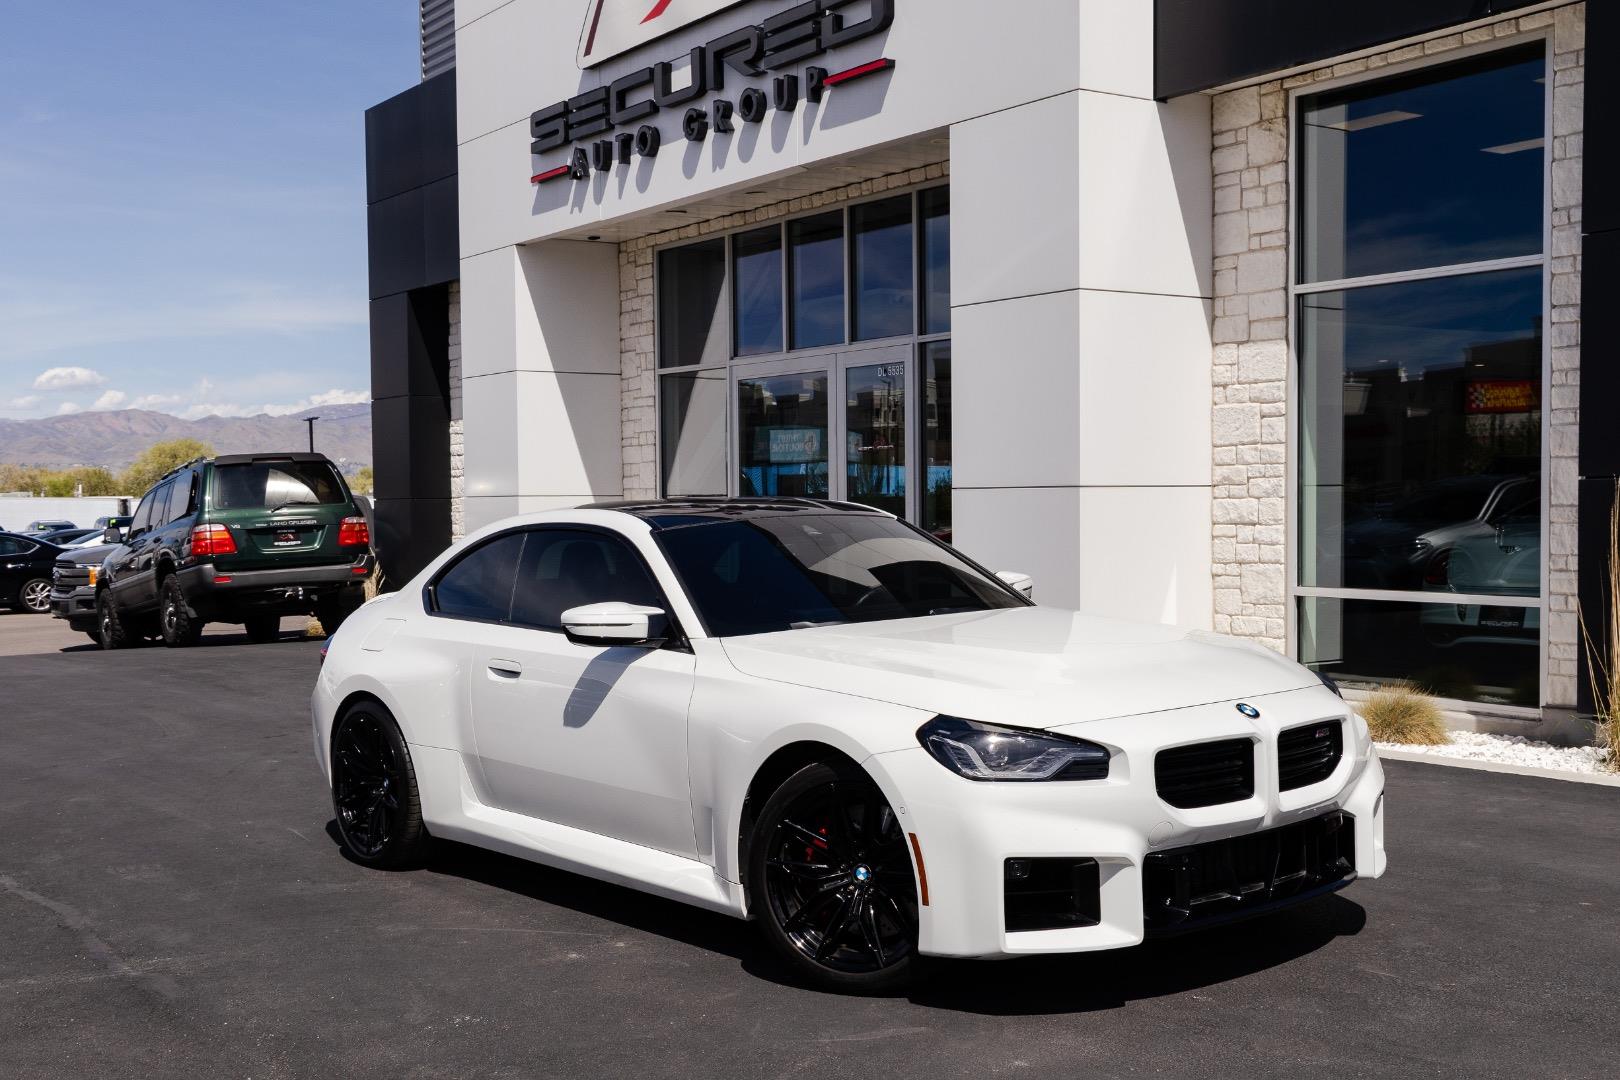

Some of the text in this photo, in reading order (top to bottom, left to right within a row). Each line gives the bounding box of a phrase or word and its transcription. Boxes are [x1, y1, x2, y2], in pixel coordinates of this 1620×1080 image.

[530, 0, 895, 155] SECURED
[569, 66, 829, 180] AUTO GROUP
[877, 366, 887, 377] DL
